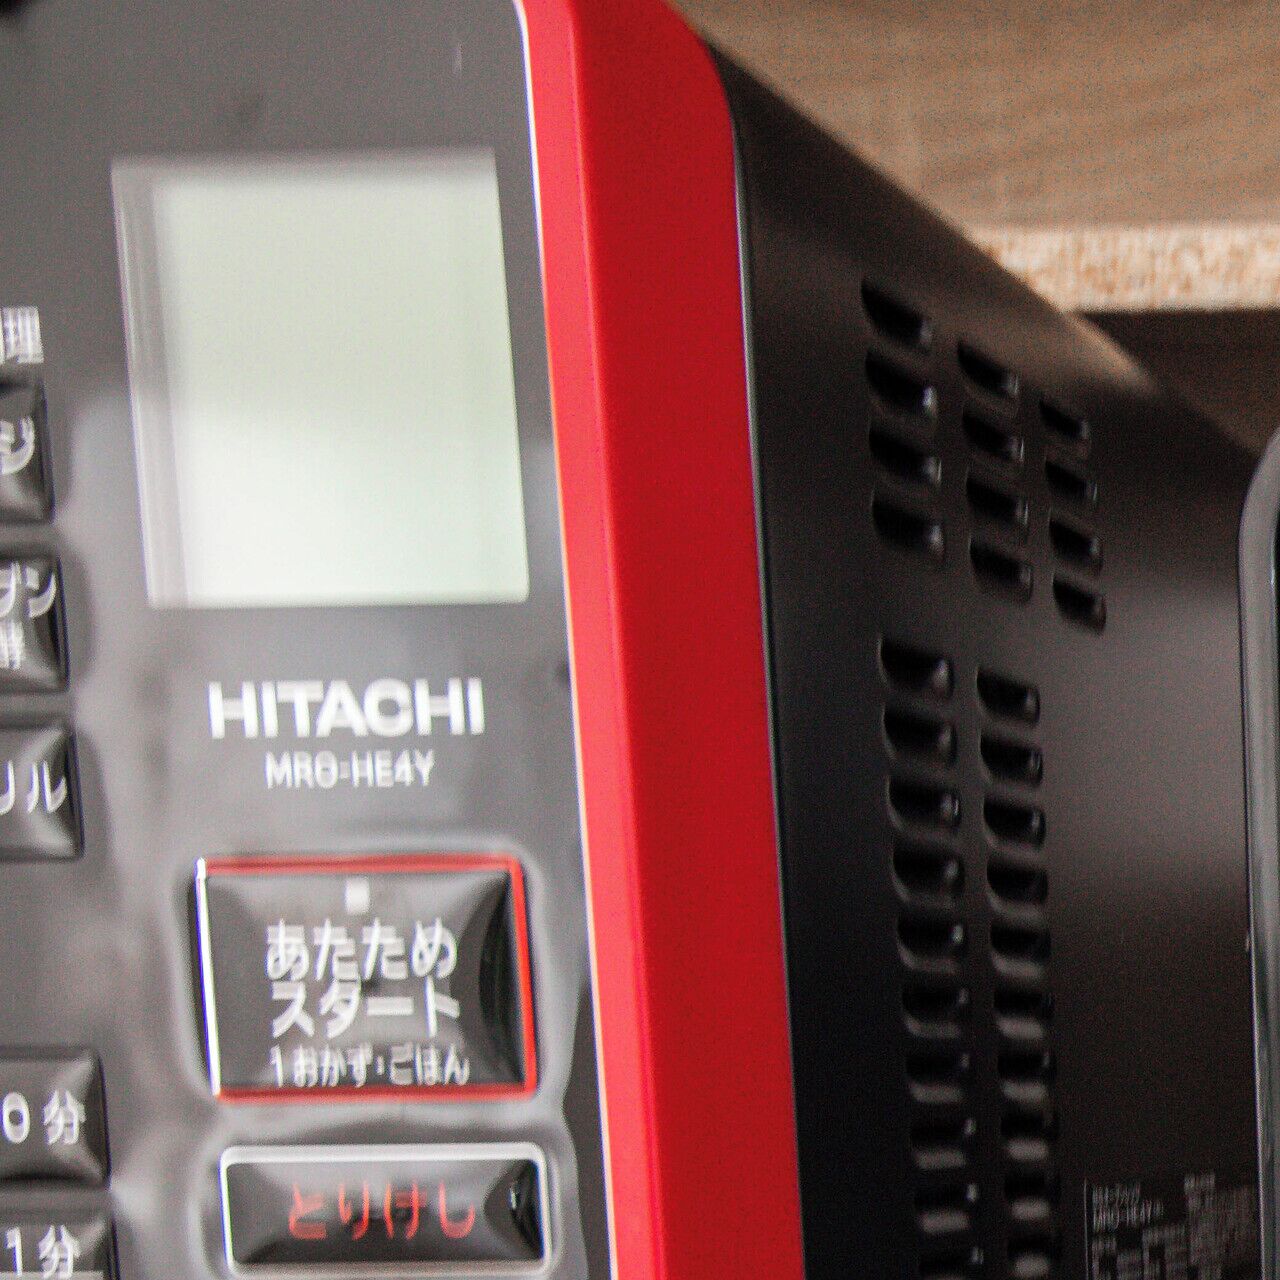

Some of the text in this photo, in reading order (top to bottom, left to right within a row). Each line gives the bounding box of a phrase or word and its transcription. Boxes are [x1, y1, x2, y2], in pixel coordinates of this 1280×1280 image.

[208, 676, 485, 739] HITACHI
[264, 750, 436, 789] MRO-HE4Y
[265, 917, 457, 981] あたため
[271, 976, 461, 1039] スタート
[288, 1181, 476, 1240] とりけし
